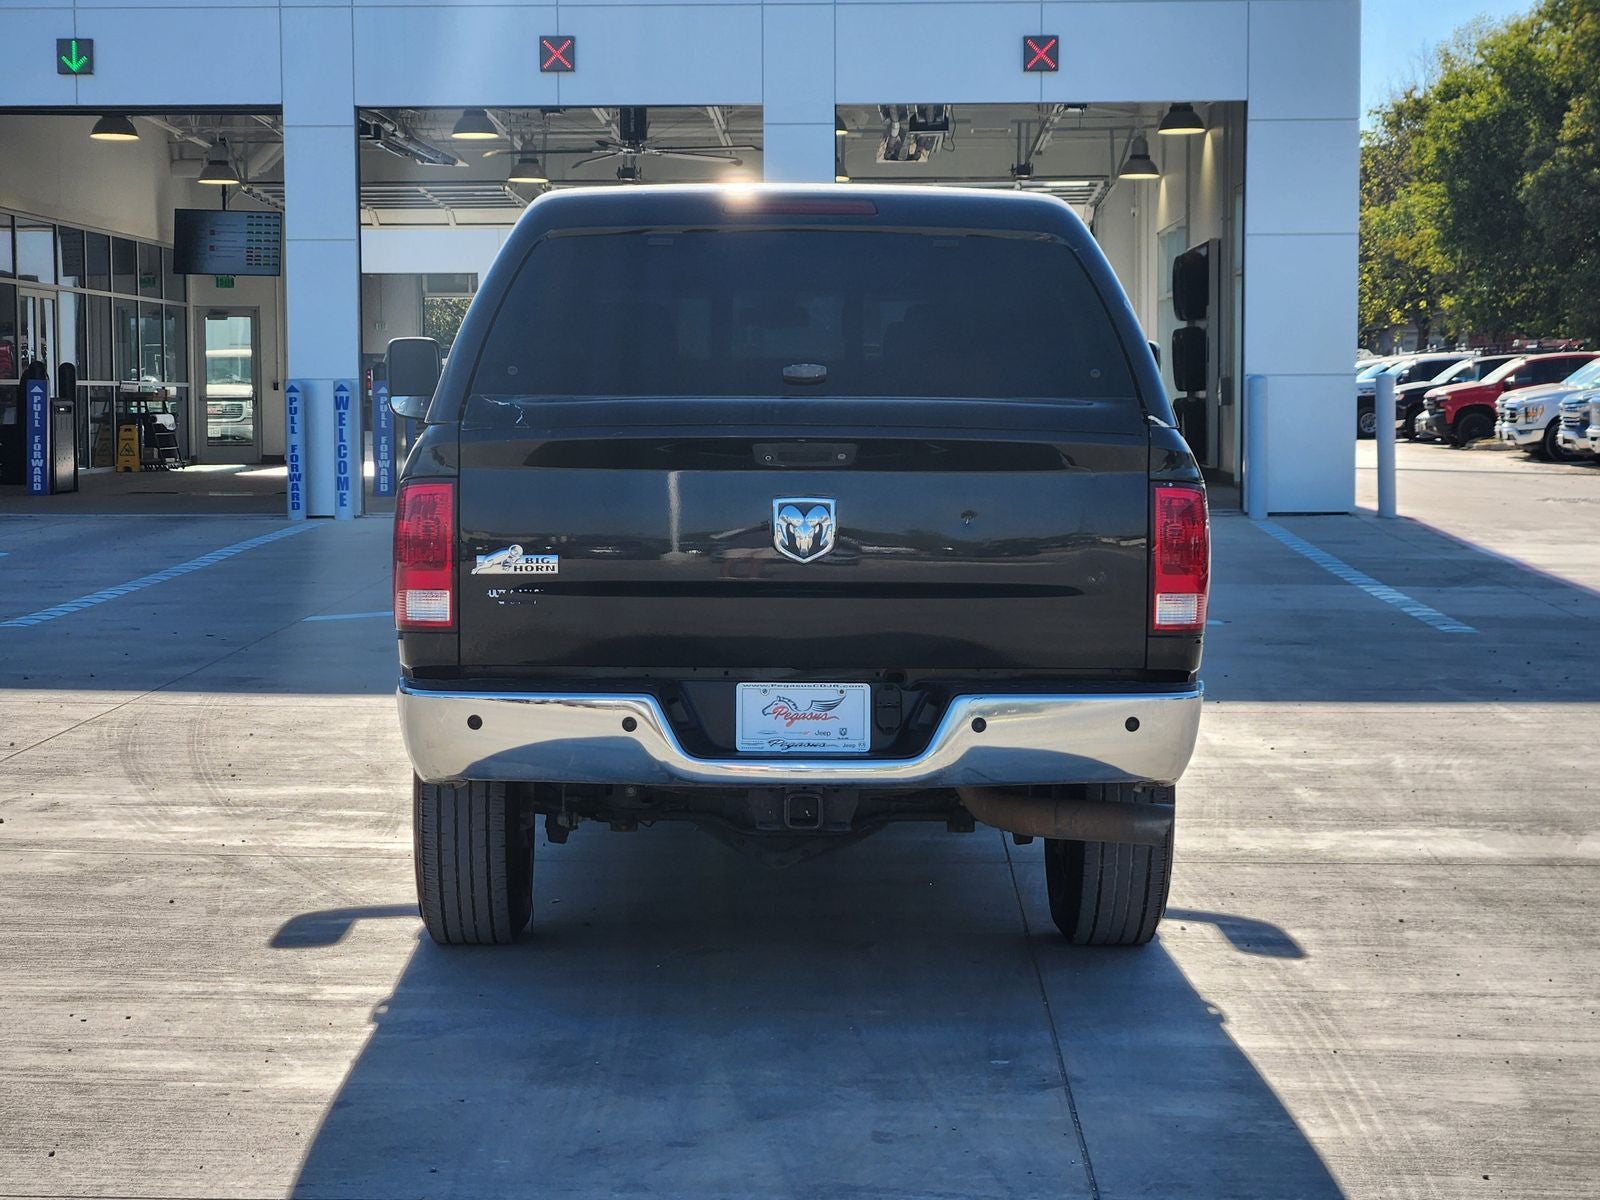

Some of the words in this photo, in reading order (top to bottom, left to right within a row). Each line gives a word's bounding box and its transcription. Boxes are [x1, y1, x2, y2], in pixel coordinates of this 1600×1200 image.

[33, 395, 41, 428] PULL
[288, 396, 298, 435] PULL
[380, 396, 388, 428] PULL
[31, 435, 44, 491] FORWARD
[335, 395, 350, 507] WELCOME
[378, 436, 391, 492] FORWARD
[289, 444, 302, 511] FORWARD
[772, 705, 840, 727] Pegasus
